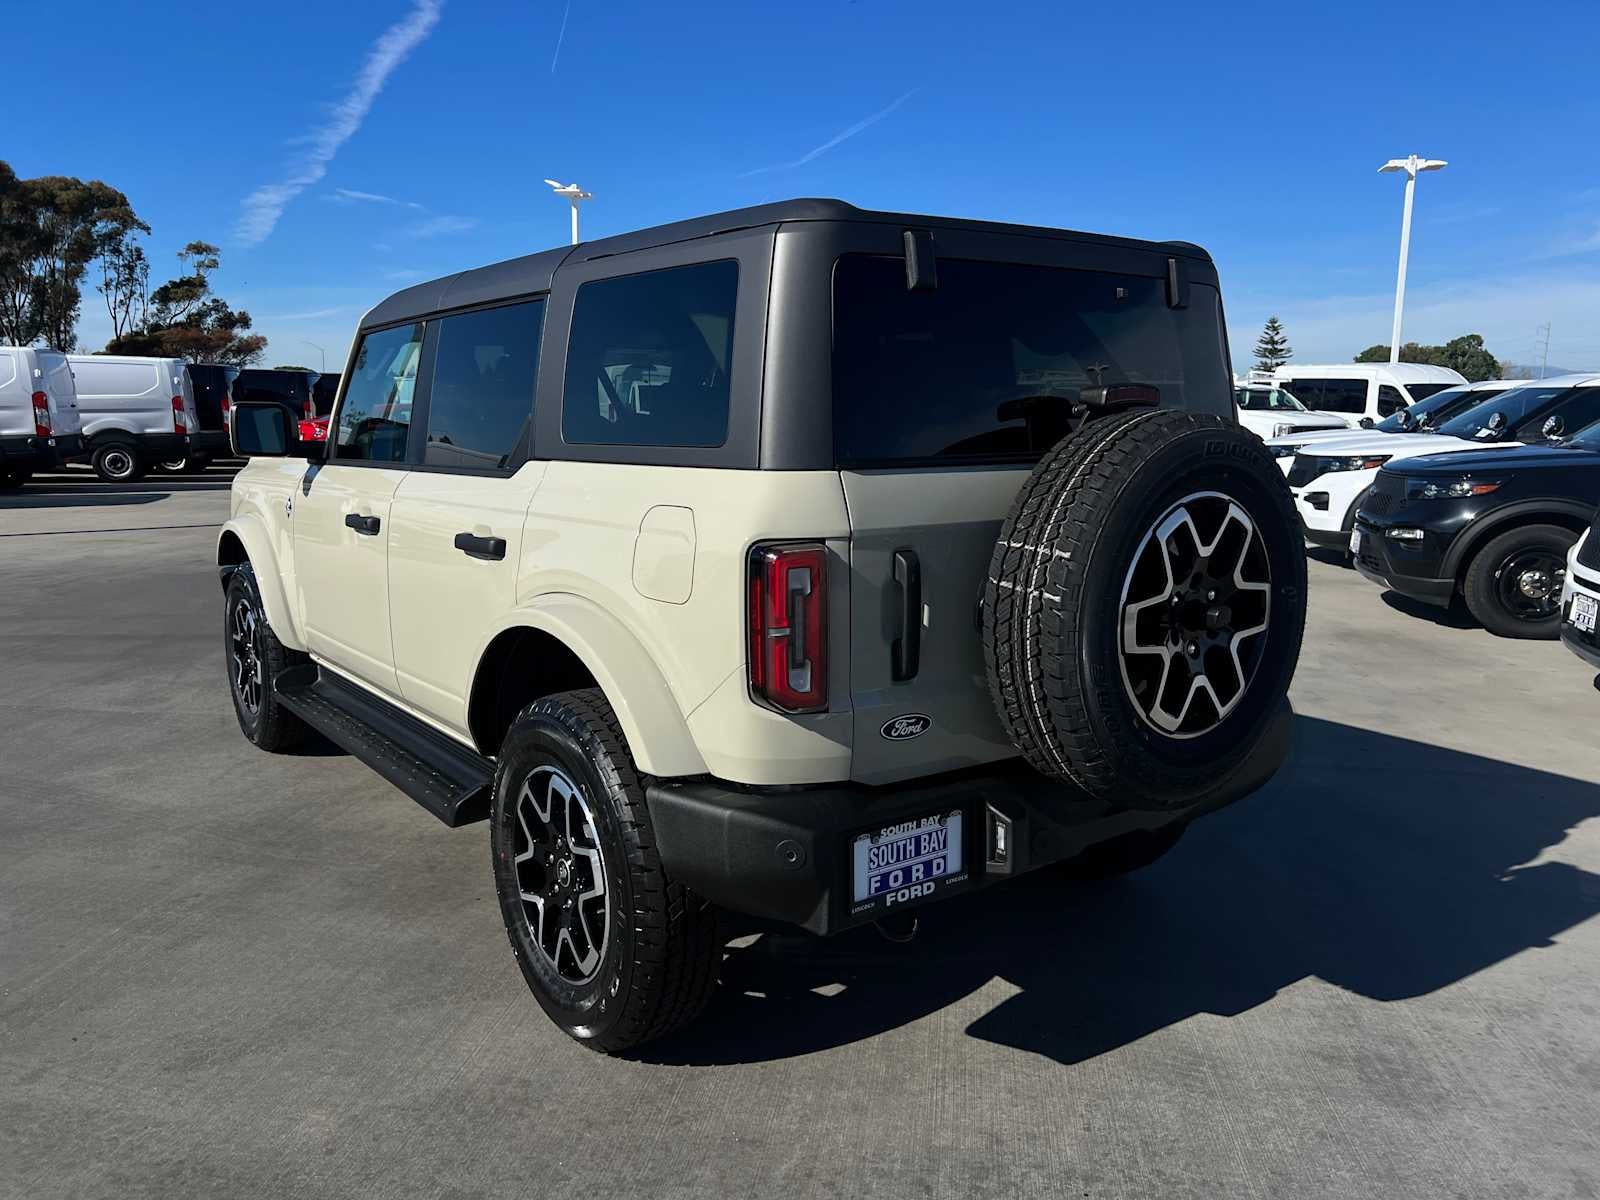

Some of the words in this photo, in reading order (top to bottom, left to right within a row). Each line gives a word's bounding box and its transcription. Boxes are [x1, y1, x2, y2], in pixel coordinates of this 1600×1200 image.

[891, 718, 924, 737] Ford
[880, 820, 917, 838] SOUTH
[920, 814, 941, 829] BAY
[869, 837, 916, 869] SOUTH
[920, 828, 947, 857] BAY
[870, 857, 945, 895] FORD
[886, 881, 936, 907] FORD
